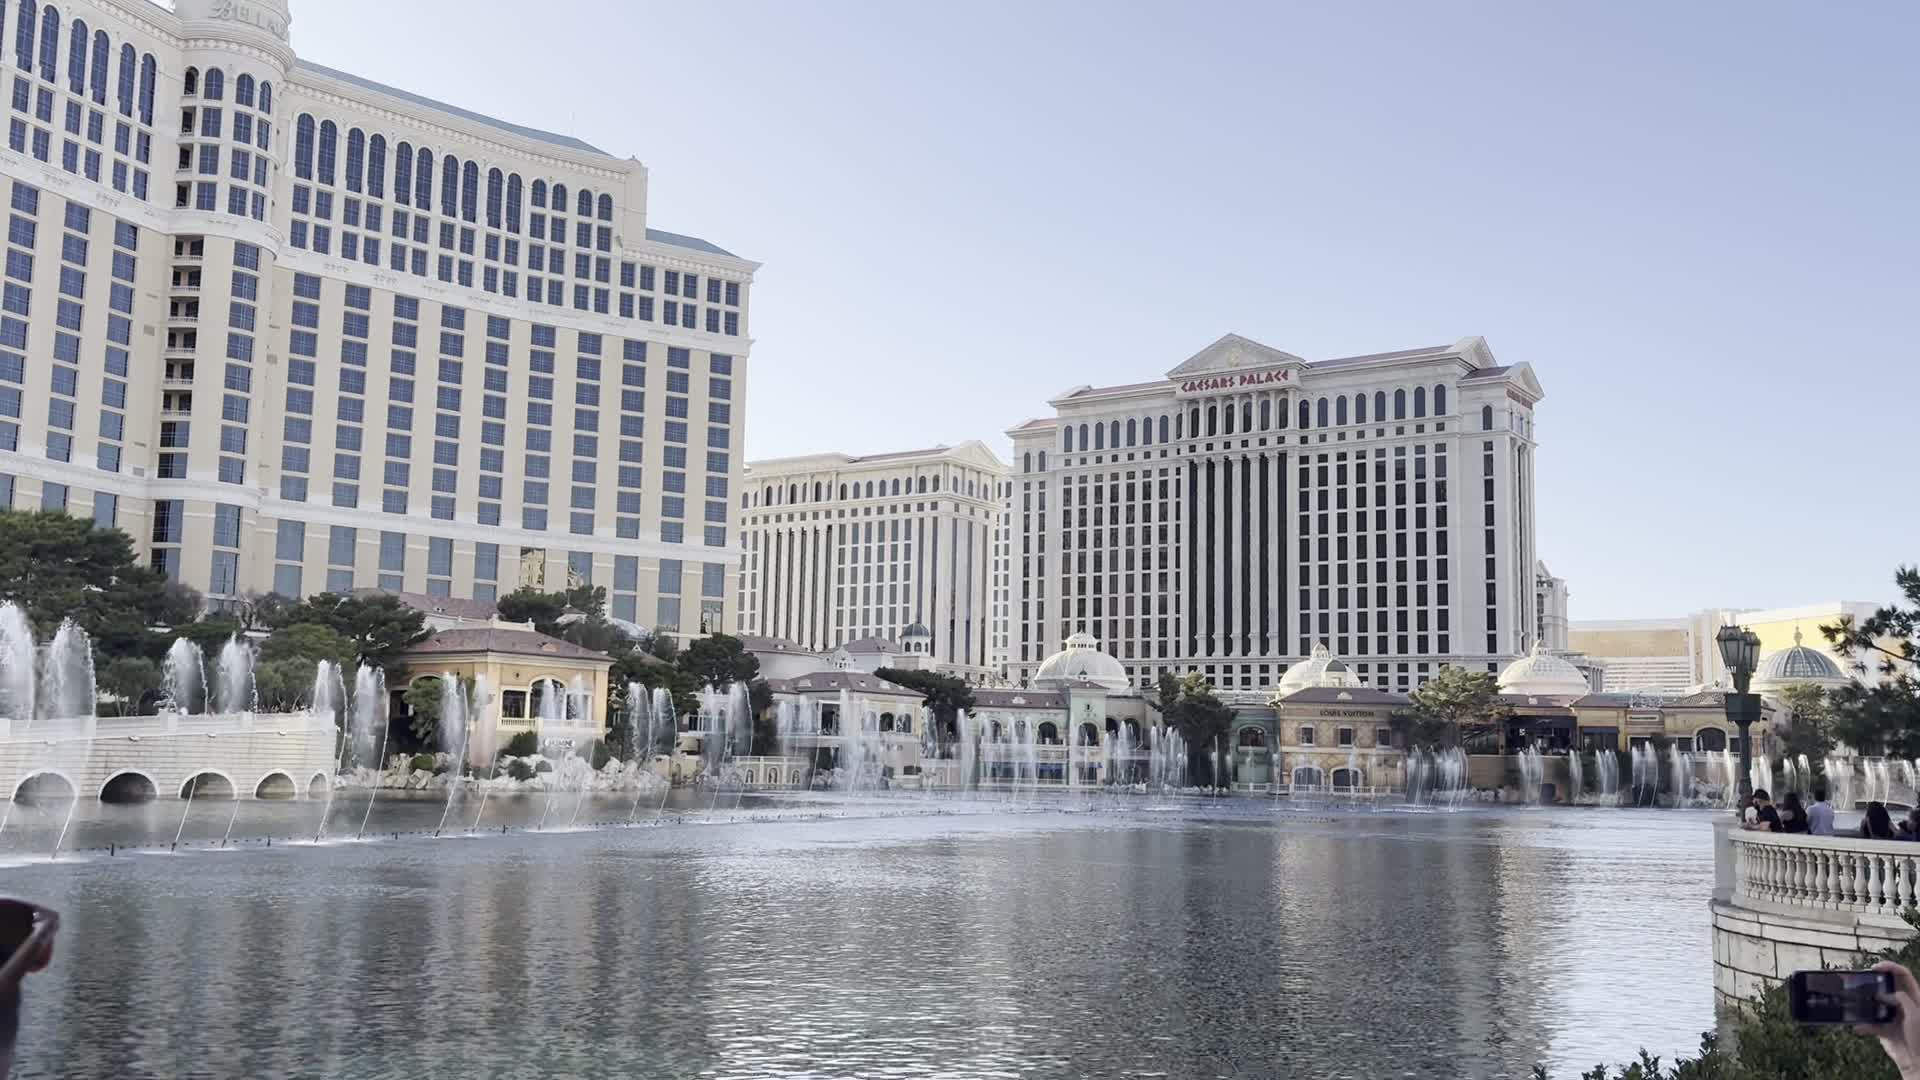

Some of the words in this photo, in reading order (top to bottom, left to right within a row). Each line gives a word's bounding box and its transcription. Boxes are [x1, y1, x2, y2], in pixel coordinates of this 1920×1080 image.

[1181, 376, 1235, 392] CAESARS
[1239, 369, 1289, 386] PALACE
[1319, 709, 1341, 718] LOUIS
